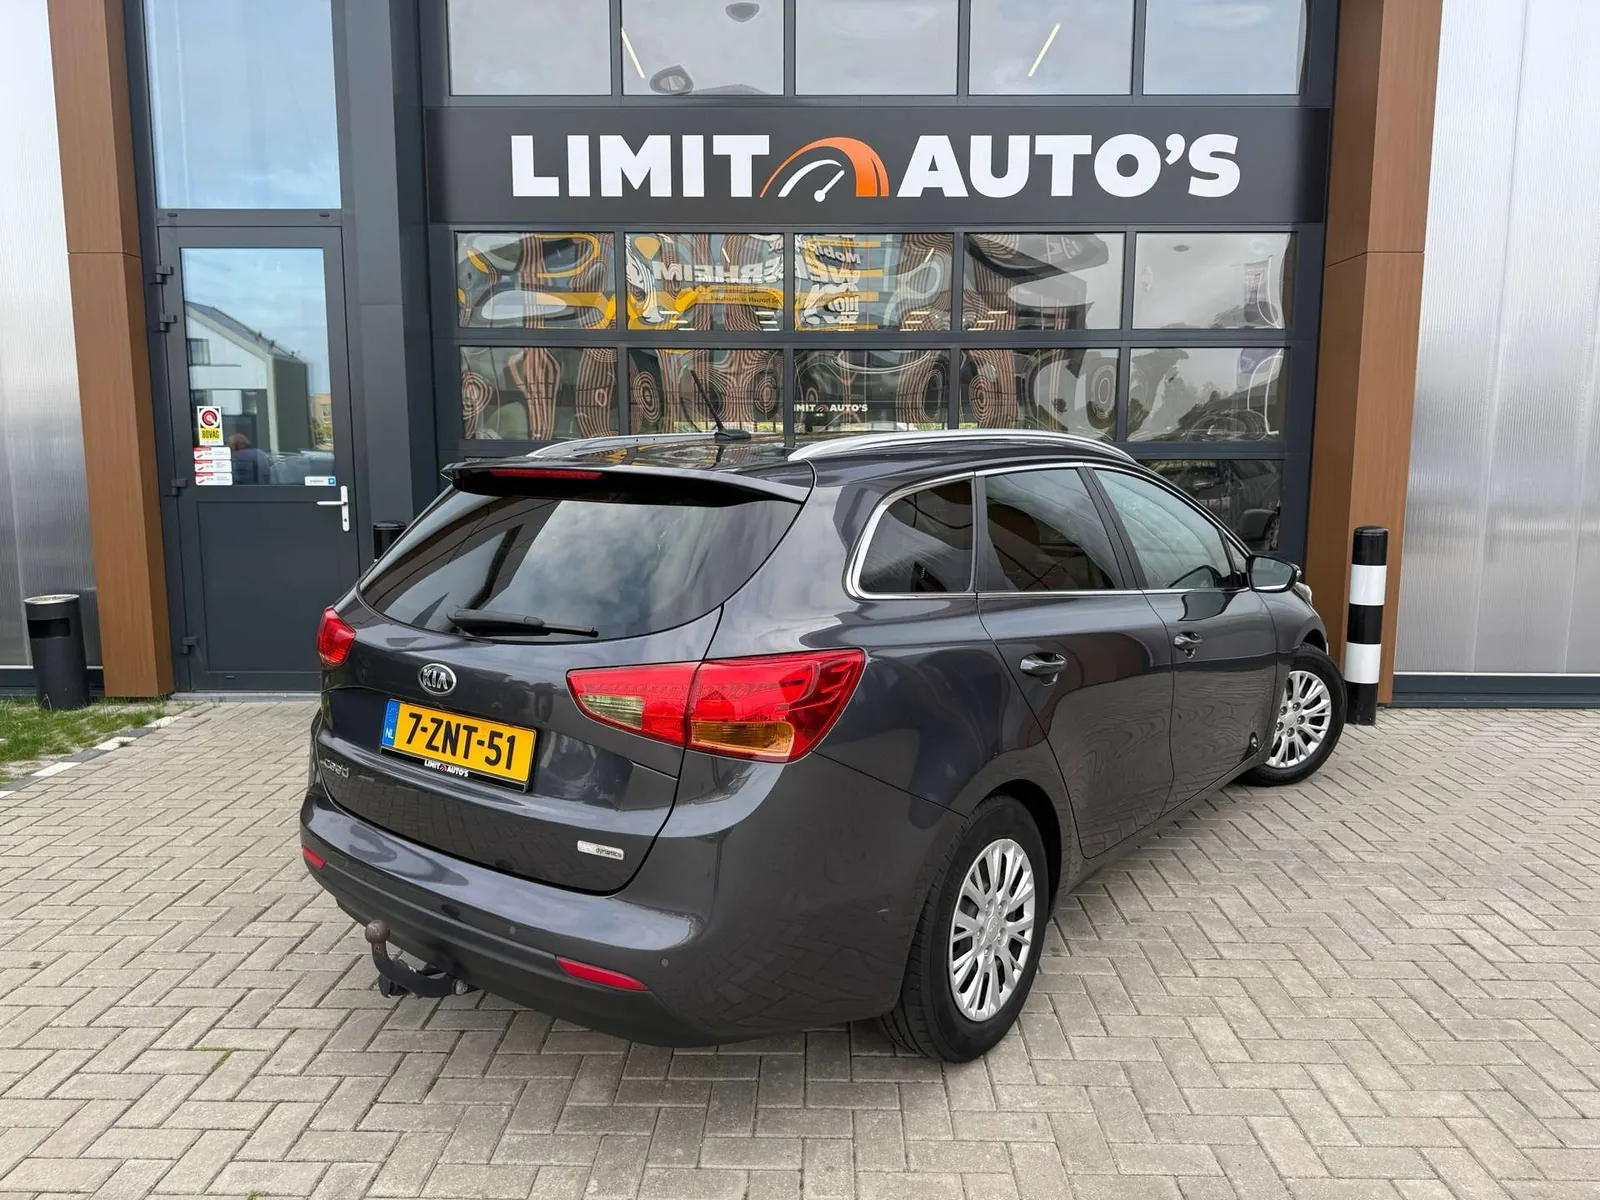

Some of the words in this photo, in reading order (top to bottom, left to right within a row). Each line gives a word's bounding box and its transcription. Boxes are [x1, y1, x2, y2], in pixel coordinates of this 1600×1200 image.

[511, 134, 770, 198] LIMIT
[896, 133, 1242, 199] AUTO'S
[829, 403, 868, 412] AUTO'S
[201, 429, 220, 439] BOVAG
[421, 668, 449, 690] KIA
[384, 727, 394, 739] NL
[405, 712, 516, 771] 7-ZNT-51
[424, 759, 441, 769] LIMIT
[447, 764, 469, 777] AUTO'S
